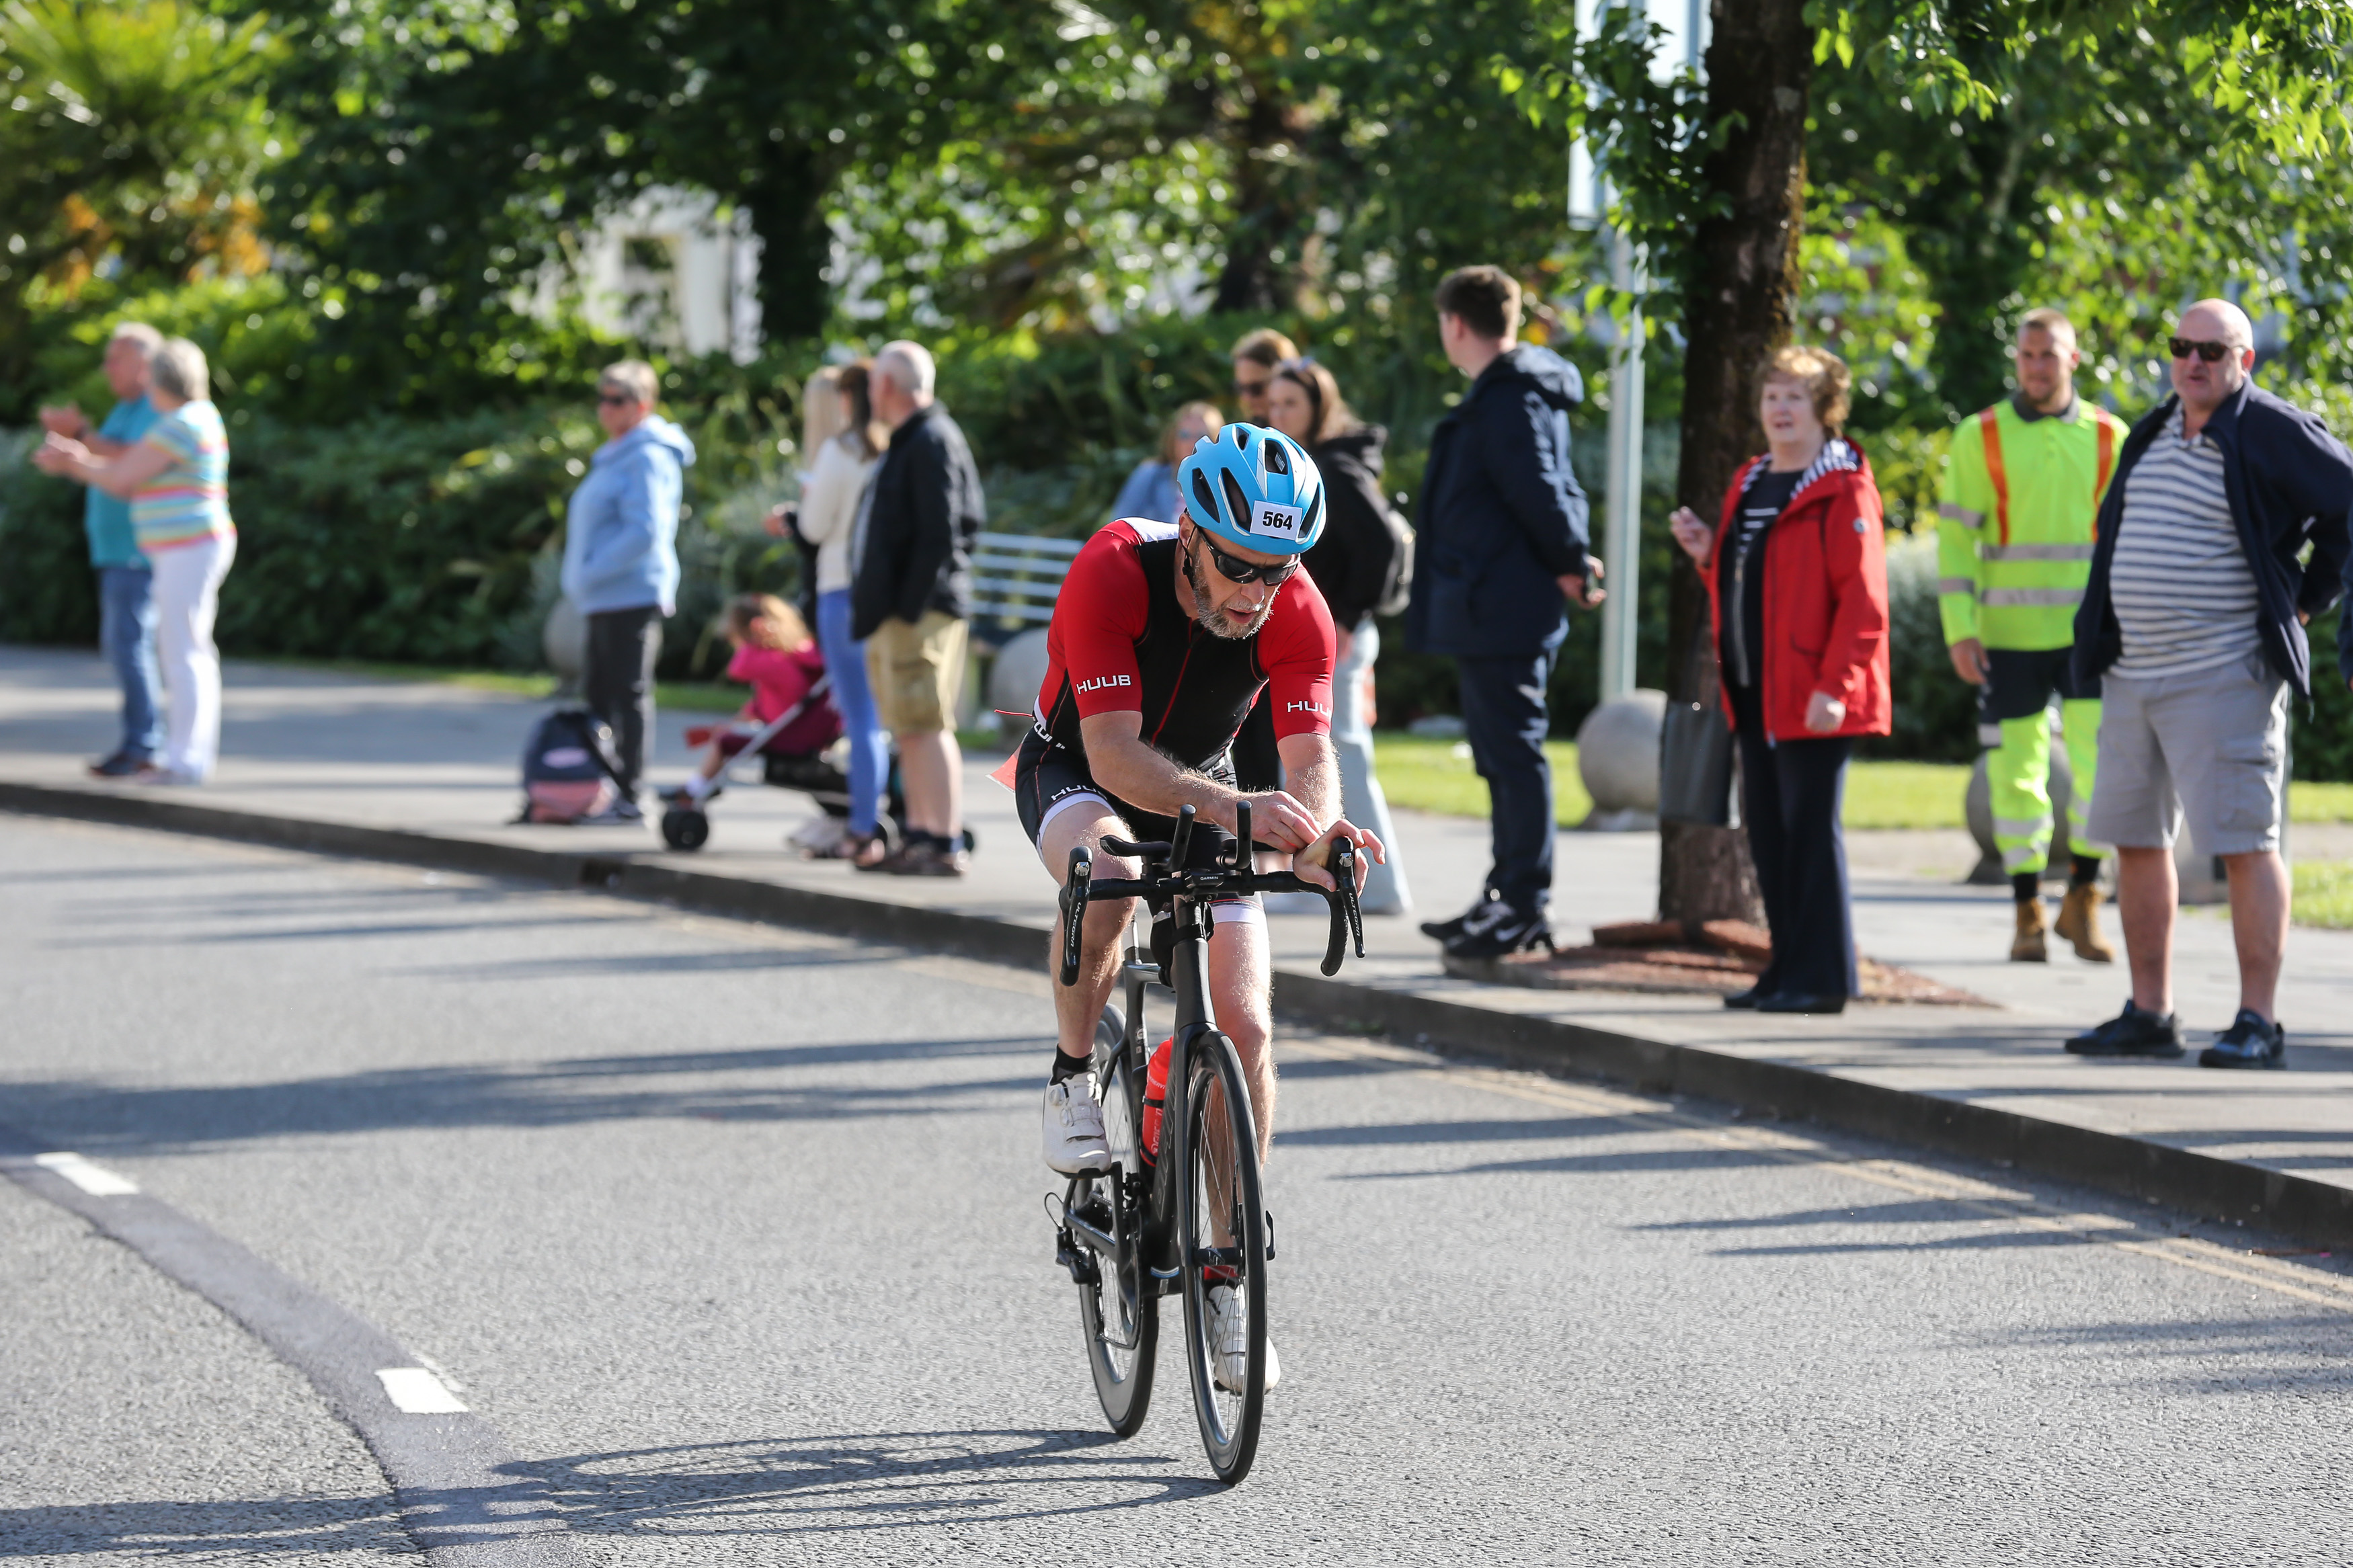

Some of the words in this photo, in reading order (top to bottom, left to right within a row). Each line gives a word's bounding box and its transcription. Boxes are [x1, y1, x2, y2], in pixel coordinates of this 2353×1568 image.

[1262, 510, 1293, 530] 564
[1076, 674, 1131, 695] HUUB
[1287, 700, 1332, 719] HUU
[1051, 784, 1108, 800] HUU
[1070, 902, 1081, 947] ULTEGRA
[1349, 893, 1361, 937] ULTEGRA
